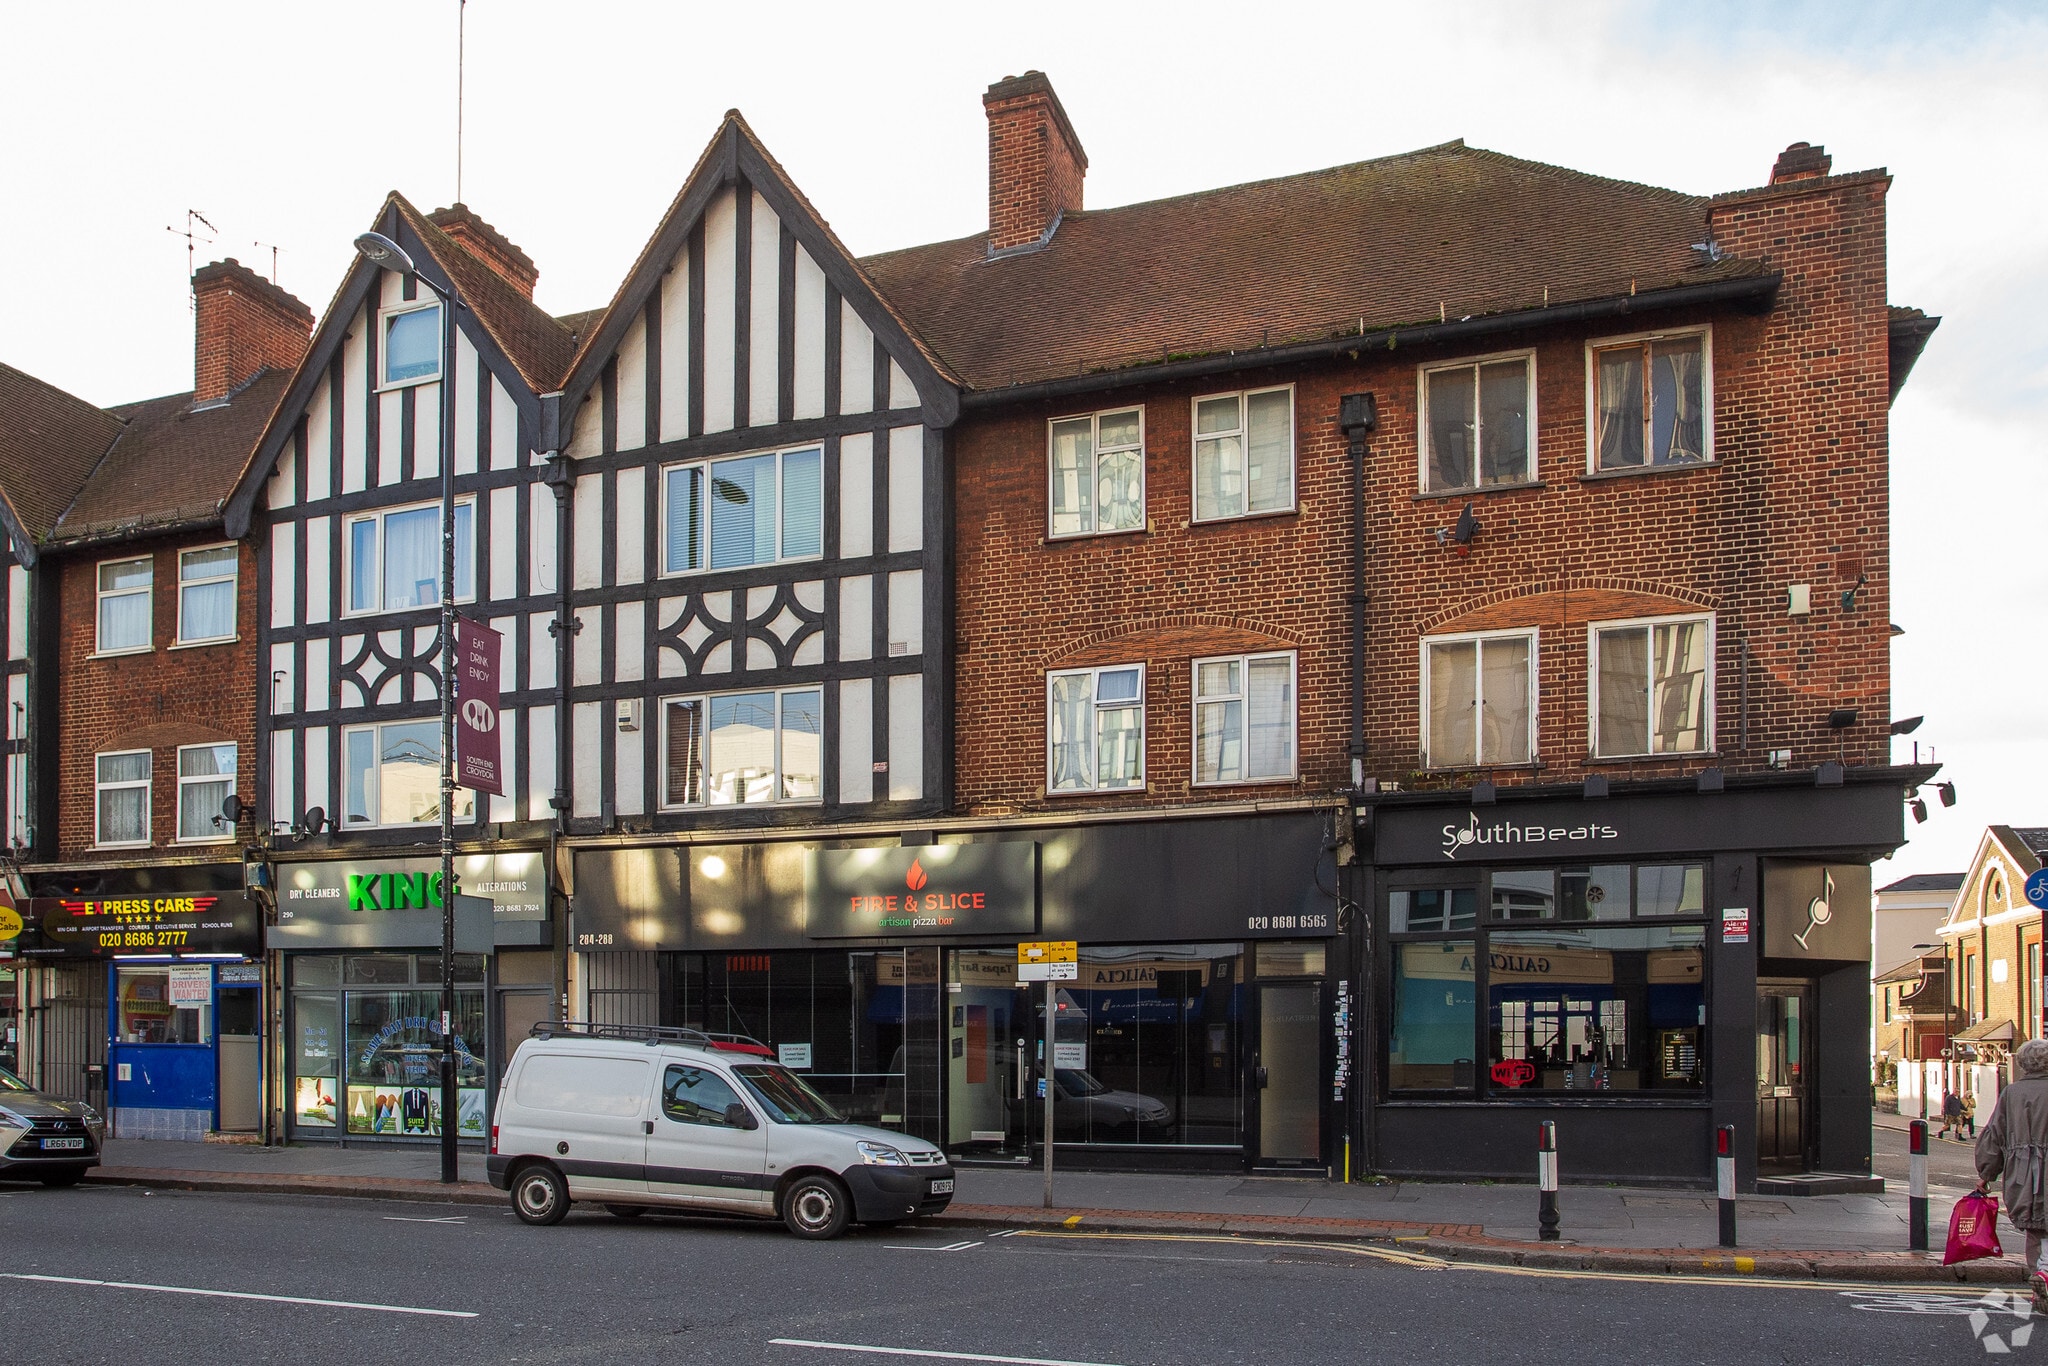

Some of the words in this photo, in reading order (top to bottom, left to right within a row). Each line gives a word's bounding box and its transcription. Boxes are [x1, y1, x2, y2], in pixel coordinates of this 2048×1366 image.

[472, 637, 485, 651] EAT
[469, 651, 489, 668] DRINK
[469, 666, 490, 682] ENJOY
[466, 756, 484, 767] SOUTH
[484, 760, 494, 769] END
[466, 766, 494, 780] CROYDON
[289, 889, 304, 900] DRY
[305, 888, 340, 899] CLEANERS
[476, 881, 527, 893] ALTERATIONS
[85, 900, 150, 915] EXPRESS
[154, 898, 195, 912] CARS
[850, 896, 898, 912] FIRE
[904, 895, 918, 912] &
[925, 892, 985, 910] SLICE
[878, 917, 910, 926] artisan
[912, 916, 936, 928] pizza
[938, 915, 954, 926] bar
[1248, 916, 1268, 930] 020
[1272, 916, 1297, 930] 8681
[1300, 914, 1327, 928] 6565
[100, 933, 120, 947] 020
[125, 932, 154, 946] 8686
[158, 931, 187, 945] 2777
[579, 933, 613, 945] 284-288
[174, 989, 208, 999] WANTED
[361, 1032, 383, 1064] SAME
[382, 1019, 402, 1038] DAY
[405, 1016, 428, 1028] DRY
[45, 1139, 66, 1148] LR66
[68, 1138, 83, 1147] VDP
